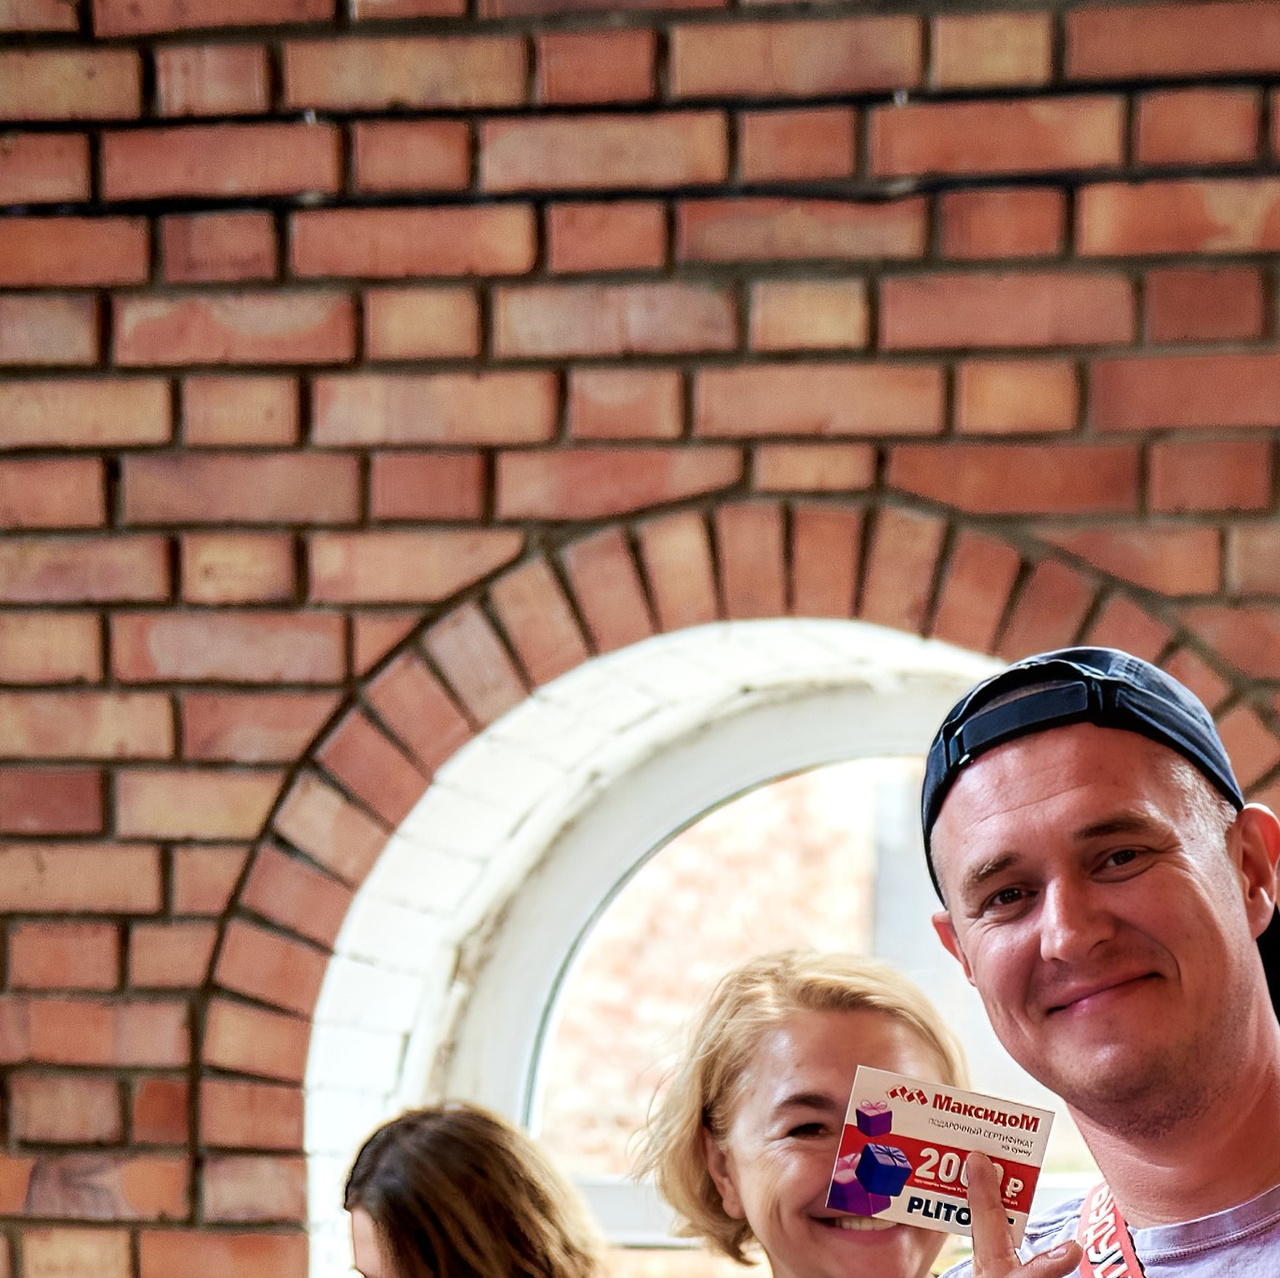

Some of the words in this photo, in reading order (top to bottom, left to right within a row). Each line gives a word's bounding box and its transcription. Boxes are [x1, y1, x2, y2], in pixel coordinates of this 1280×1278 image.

[928, 1117, 983, 1136] ПОДАРОЧНЫЙ
[983, 1129, 1034, 1148] СЕРТИФИКАТ
[907, 1196, 1015, 1226] PLITO
